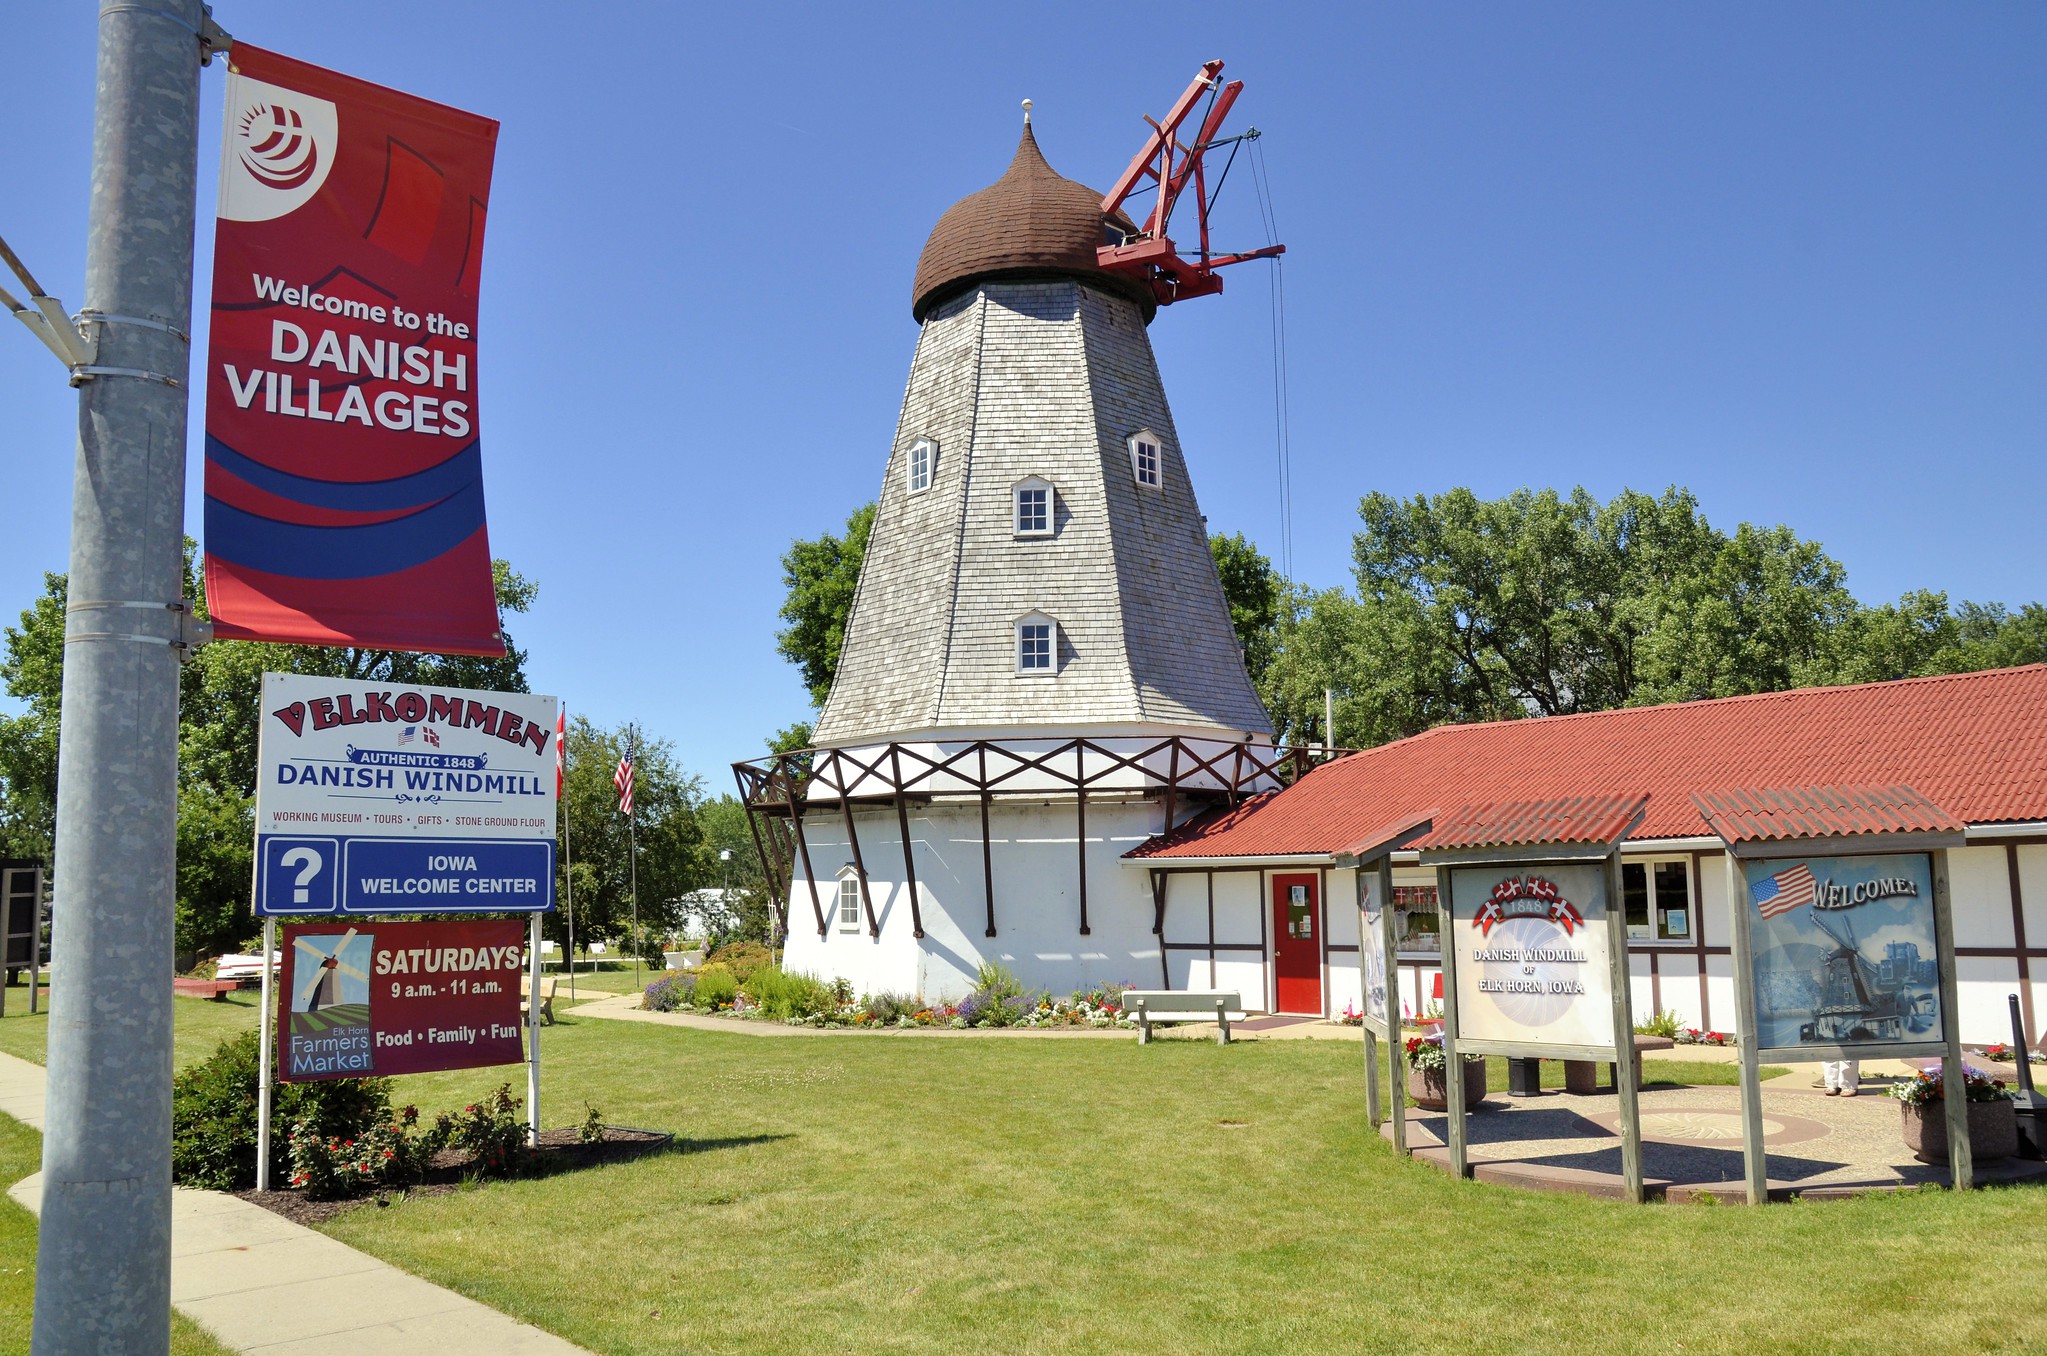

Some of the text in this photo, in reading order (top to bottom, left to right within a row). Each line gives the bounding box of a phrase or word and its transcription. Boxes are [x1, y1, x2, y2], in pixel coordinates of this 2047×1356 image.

[252, 273, 470, 340] Welcome to the
[271, 319, 467, 391] DANISH
[223, 363, 470, 437] VILLAGES
[272, 692, 550, 756] VELKOMMEN
[360, 752, 476, 769] AUTHENTIC 1848
[277, 763, 545, 795] DANISH WINDMILL
[273, 811, 545, 827] WORKING MUSEUM TOURS GIFTS STONE GROUND FLOUR
[428, 855, 477, 871] IOWA
[280, 846, 323, 903] ?
[361, 878, 536, 894] WELCOME CENTER
[1811, 877, 1917, 909] WELCOME!
[1509, 899, 1542, 914] 1848
[375, 945, 521, 975] SATURDAYS
[1473, 947, 1587, 962] DANISH WINDMILL
[1523, 965, 1535, 975] OF
[391, 982, 401, 998] 9
[405, 984, 437, 998] a.m.
[450, 979, 467, 995] 11
[471, 980, 503, 994] a.m.
[1478, 980, 1584, 995] ELK HORN, IOWA
[333, 1026, 369, 1036] Elk Horn
[376, 1023, 517, 1048] Food Family Fun
[292, 1035, 369, 1054] Farmers
[293, 1051, 370, 1073] Market
